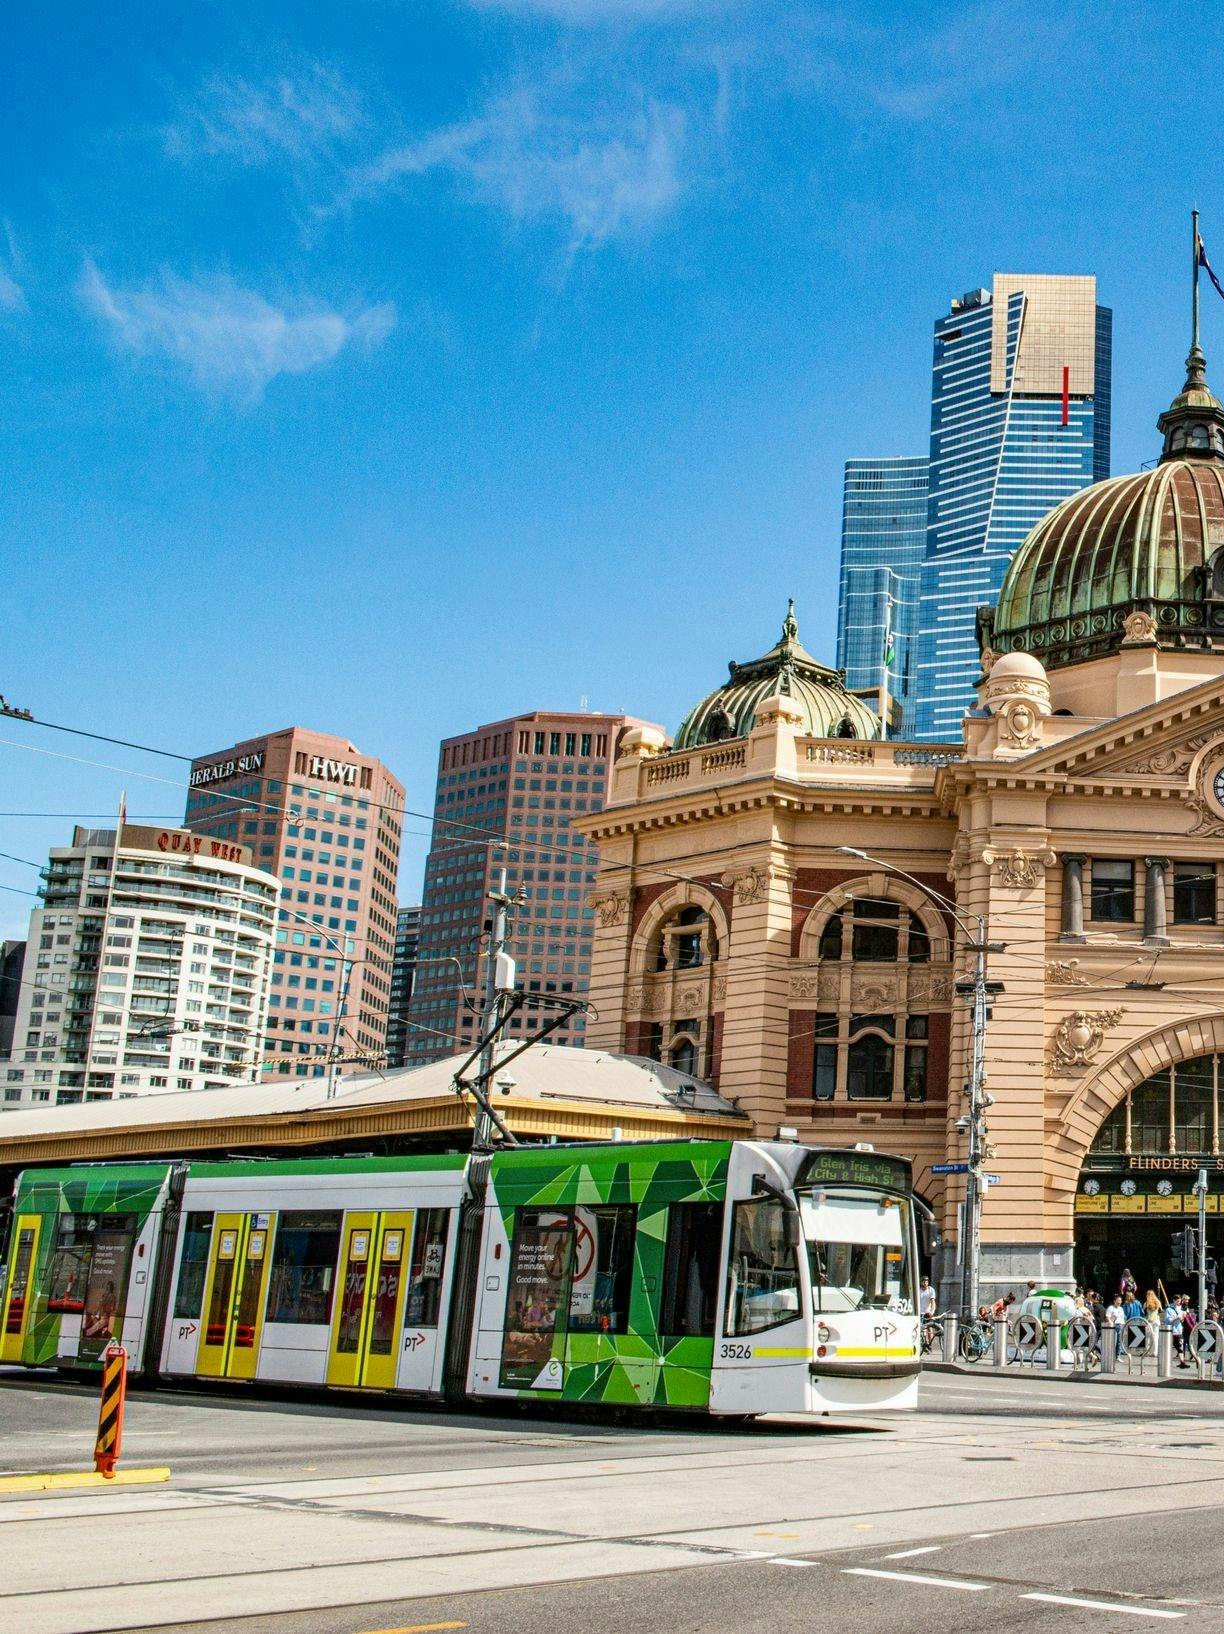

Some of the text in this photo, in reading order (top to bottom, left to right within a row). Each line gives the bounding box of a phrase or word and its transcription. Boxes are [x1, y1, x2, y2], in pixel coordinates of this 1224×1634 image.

[189, 753, 263, 786] HERALD SUN
[311, 756, 360, 783] HWT
[158, 832, 242, 863] QUAY WEST
[820, 1157, 891, 1175] Glen Iris via
[1129, 1157, 1199, 1170] FLINDERS
[814, 1168, 895, 1185] City & High St
[519, 1244, 548, 1253] Move your
[518, 1253, 555, 1263] energy online
[516, 1275, 532, 1284] Good
[892, 1299, 913, 1313] 3526
[720, 1344, 752, 1360] 3526
